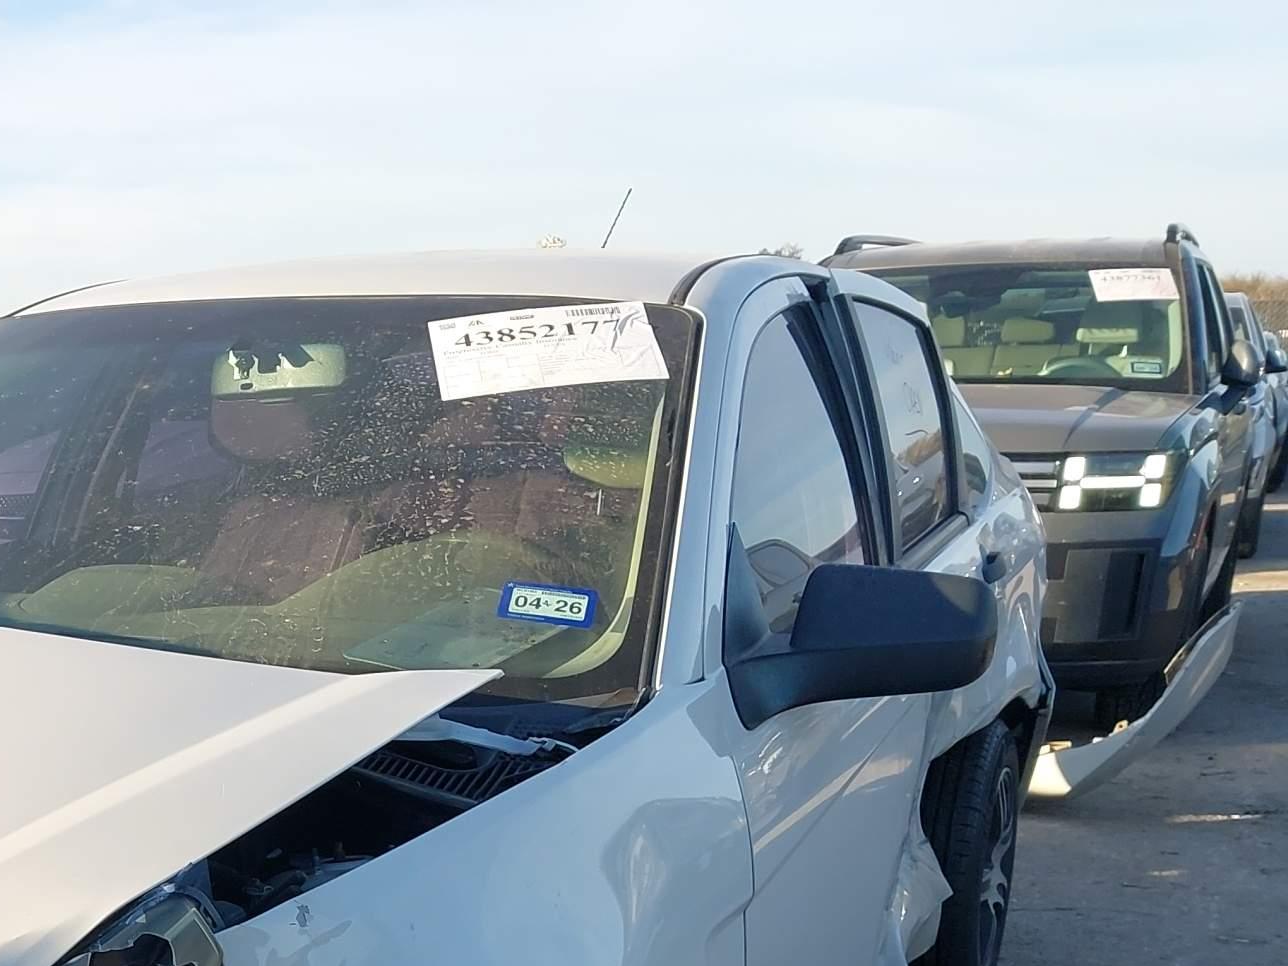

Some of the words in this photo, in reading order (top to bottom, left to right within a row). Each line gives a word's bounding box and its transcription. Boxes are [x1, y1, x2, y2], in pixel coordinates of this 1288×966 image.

[454, 318, 621, 348] 43852177
[514, 595, 542, 610] 04
[554, 599, 582, 615] 26
